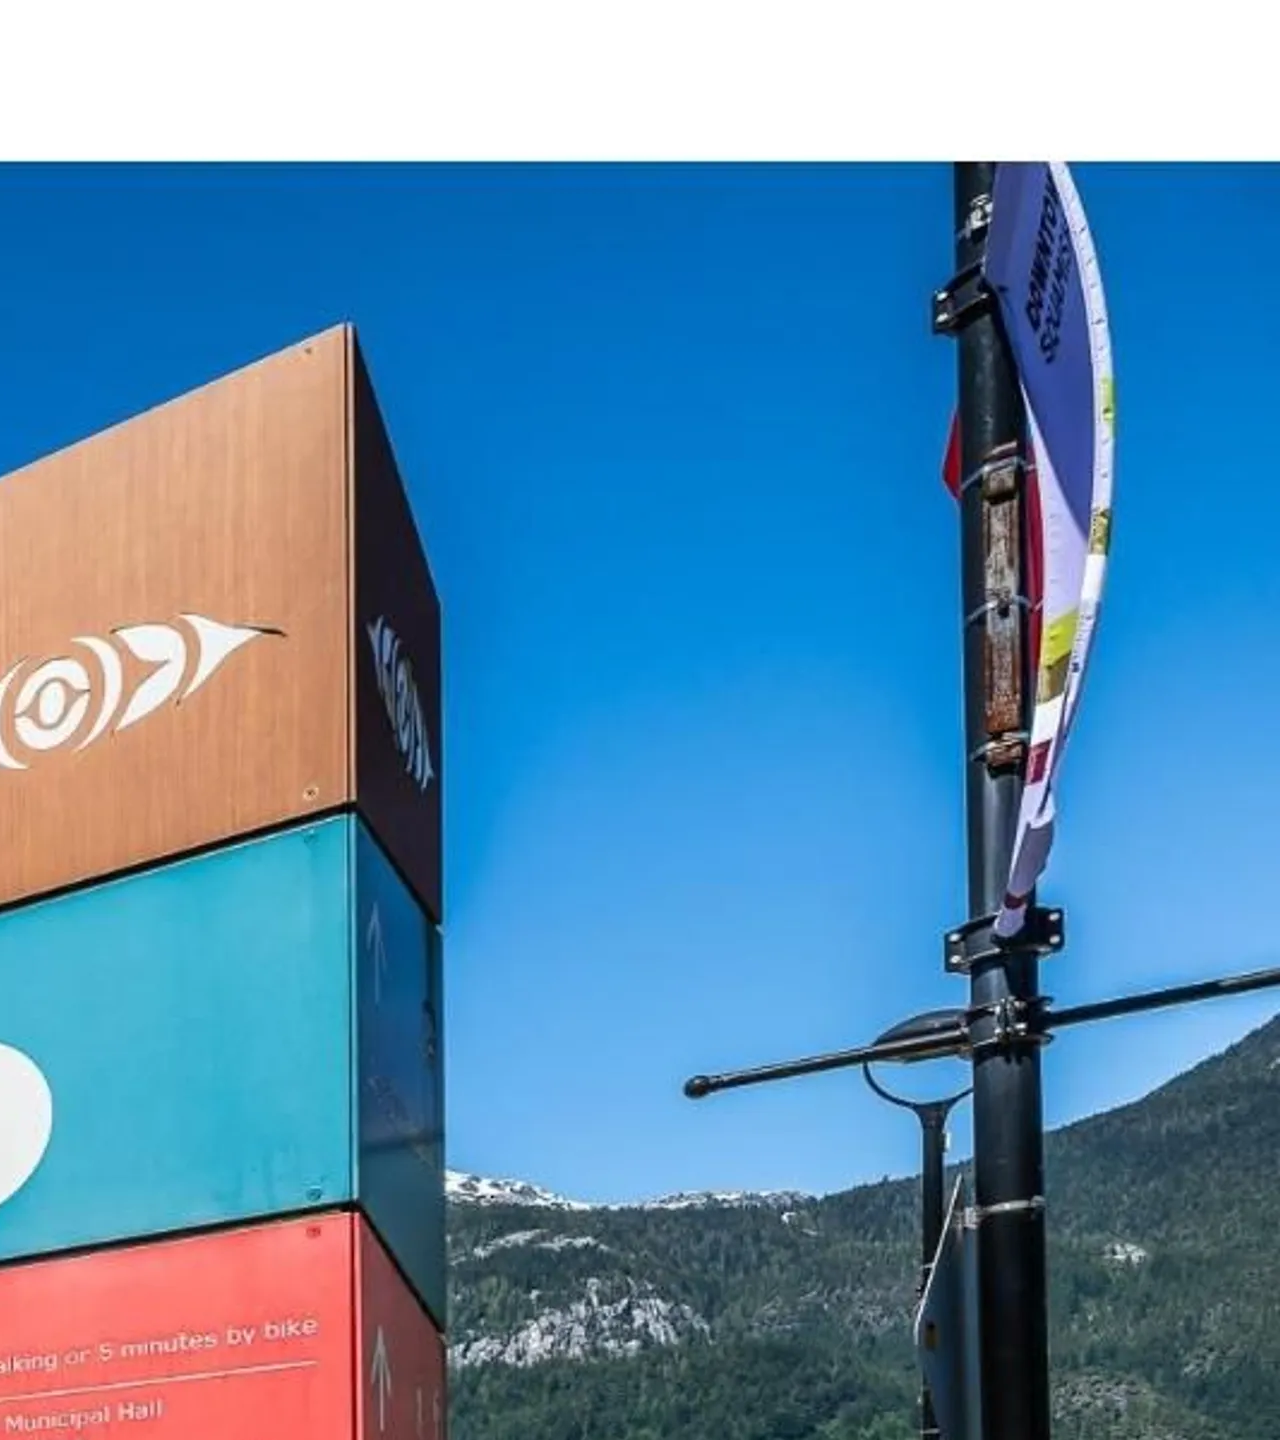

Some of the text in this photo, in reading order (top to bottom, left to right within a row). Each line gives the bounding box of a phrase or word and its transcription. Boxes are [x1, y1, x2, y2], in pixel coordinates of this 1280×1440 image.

[65, 1348, 90, 1364] or
[99, 1343, 112, 1361] 5
[121, 1332, 218, 1357] minutes
[228, 1326, 256, 1345] by
[264, 1317, 318, 1340] bike
[6, 1407, 110, 1432] Municipal
[118, 1399, 162, 1421] Hall
